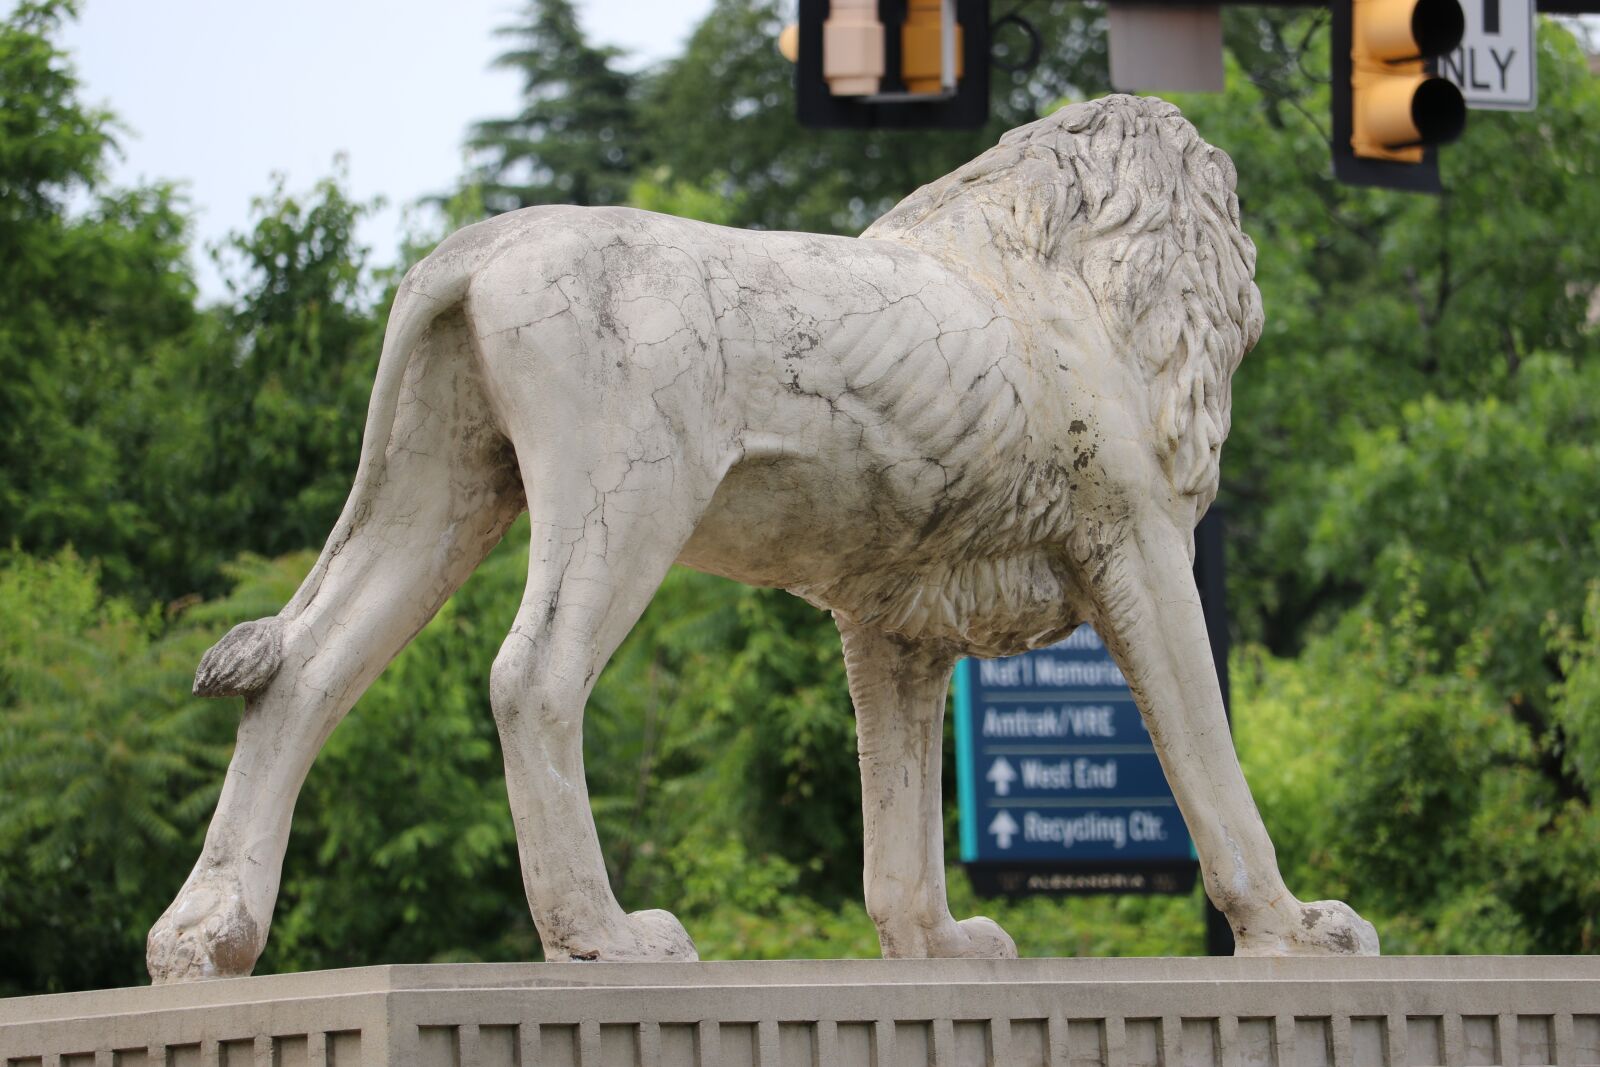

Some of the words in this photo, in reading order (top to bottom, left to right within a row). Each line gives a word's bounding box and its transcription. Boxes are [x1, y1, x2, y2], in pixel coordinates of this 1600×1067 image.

[1443, 46, 1516, 92] NLY
[1035, 657, 1127, 687] Memoria
[983, 706, 1115, 737] Amtrak/VRE
[1020, 759, 1071, 788] West
[1074, 759, 1117, 788] End
[1024, 811, 1126, 848] Recycling
